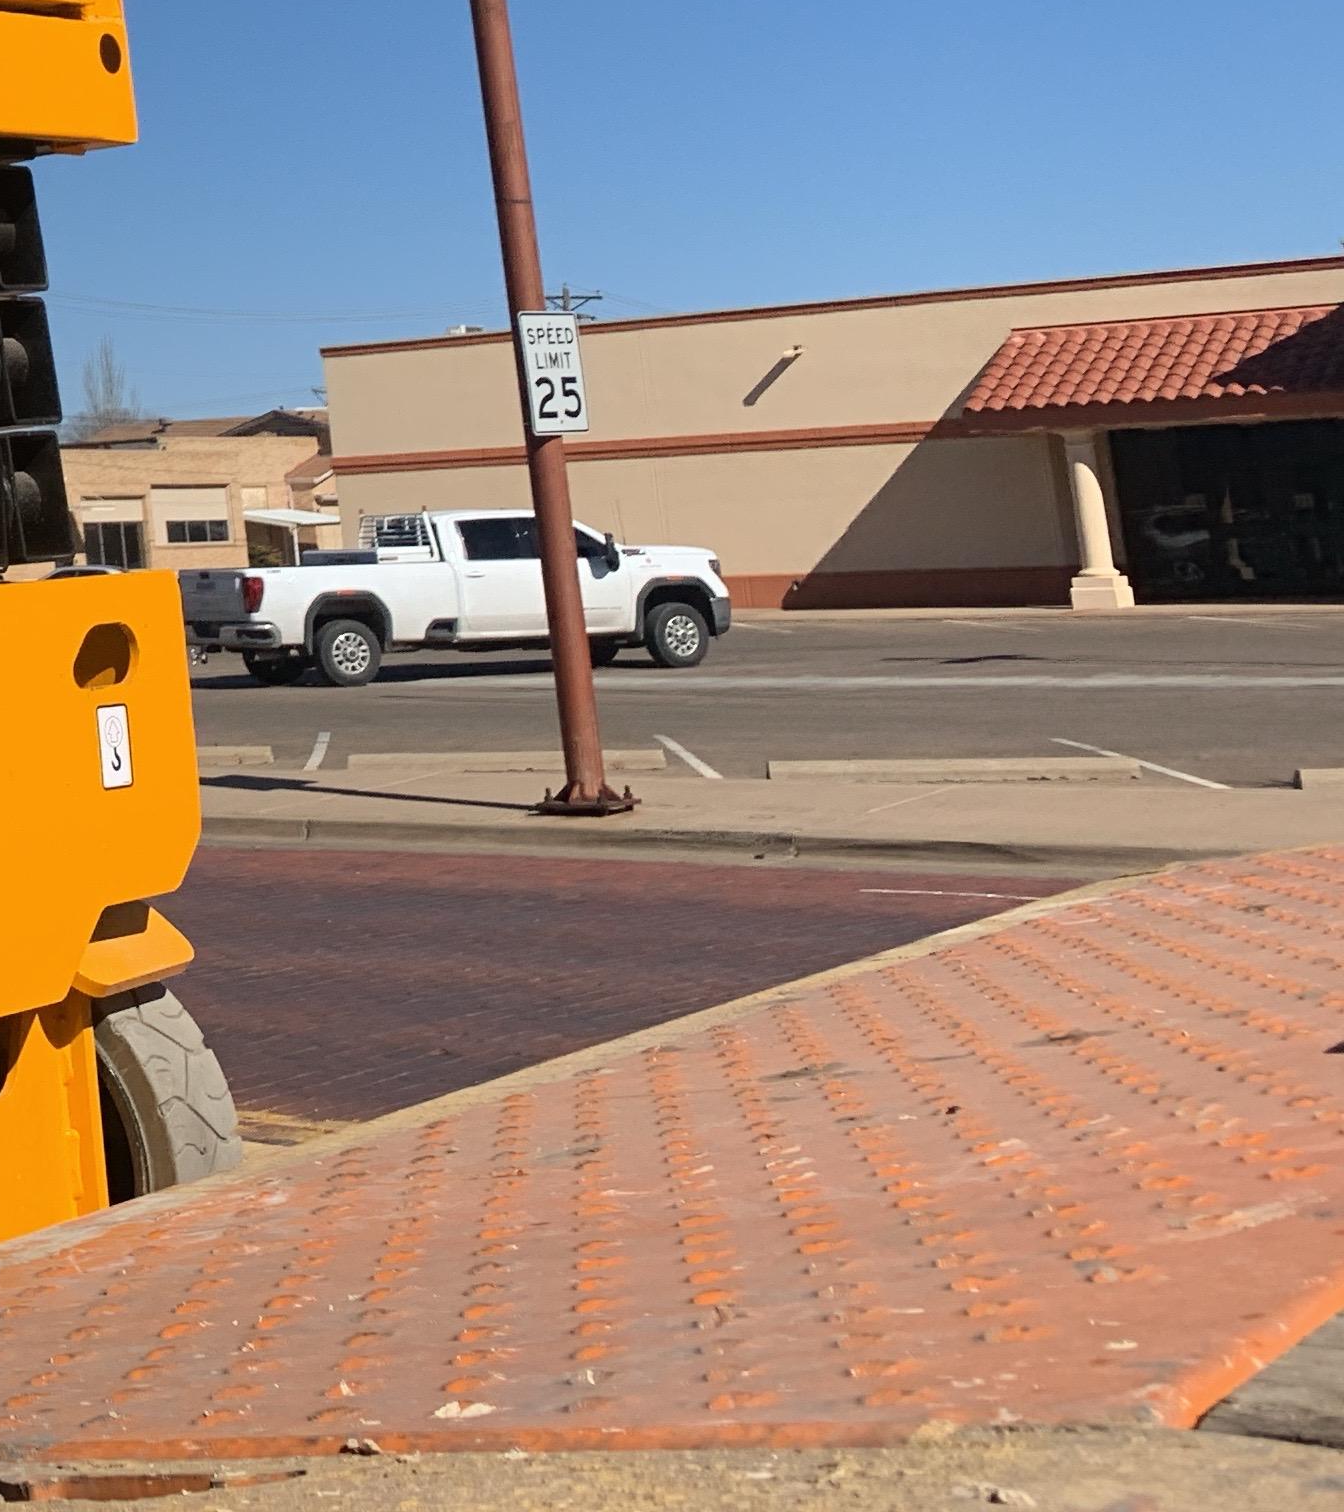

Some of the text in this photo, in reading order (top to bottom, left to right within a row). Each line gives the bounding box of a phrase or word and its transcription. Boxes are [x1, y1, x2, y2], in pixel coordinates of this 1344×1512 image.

[526, 327, 574, 345] SPEED
[535, 351, 571, 369] LIMIT
[535, 376, 582, 419] 25
